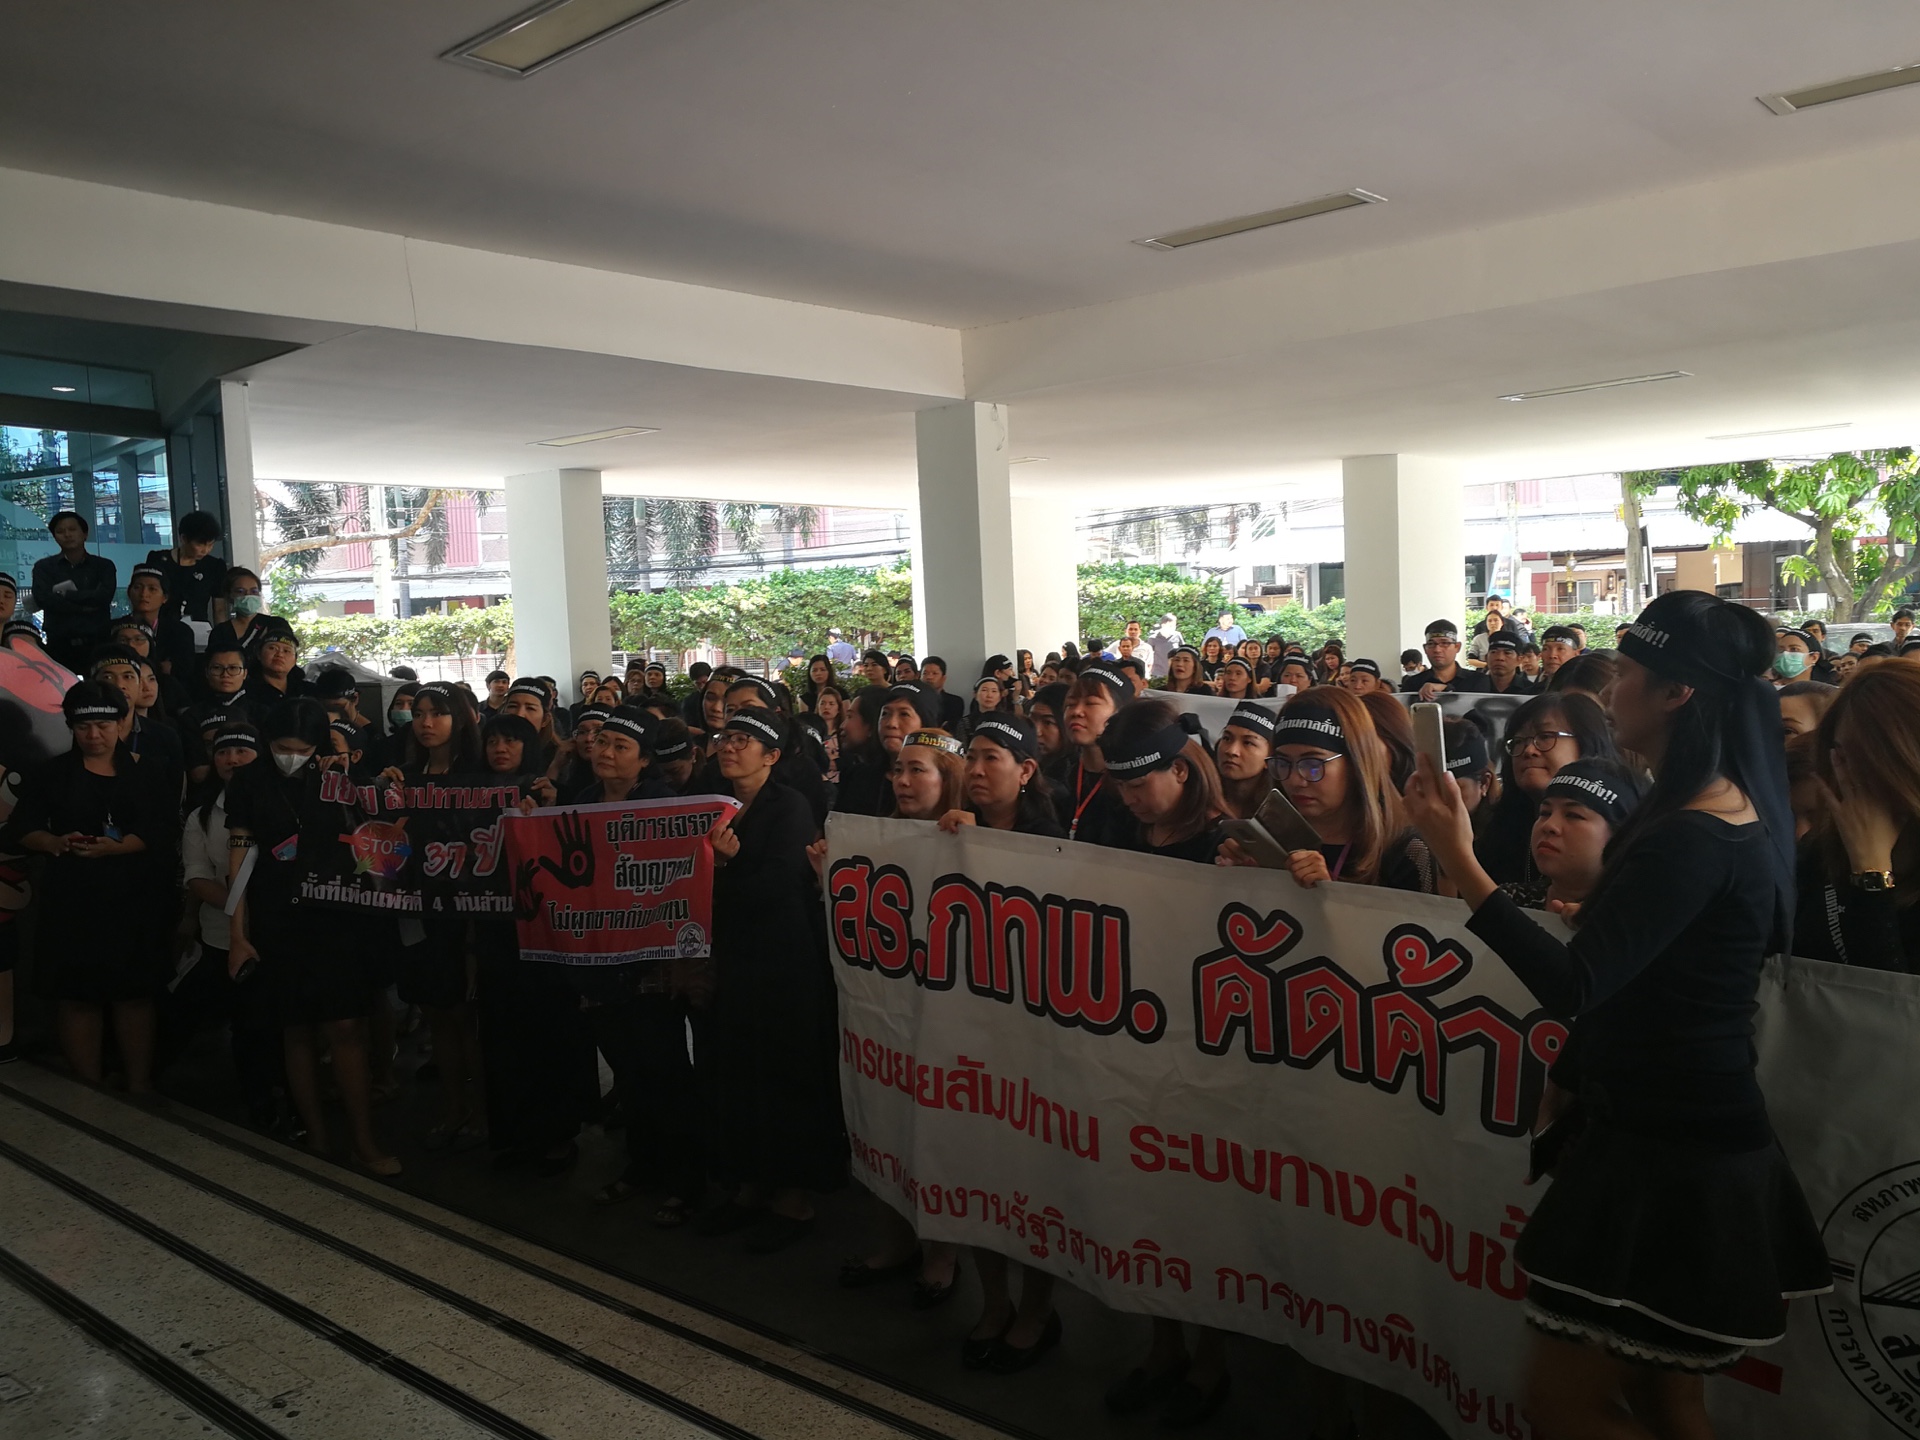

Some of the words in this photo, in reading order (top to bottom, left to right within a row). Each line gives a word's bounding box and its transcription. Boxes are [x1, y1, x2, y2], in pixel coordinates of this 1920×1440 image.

[319, 769, 379, 816] ขยย
[423, 841, 468, 879] 37
[432, 895, 444, 912] 4
[843, 1026, 1100, 1163] การขยยสัมปทาน
[1214, 1266, 1540, 1440] การทางพิเศษแ
[1828, 1307, 1920, 1430] การทางพิเ
